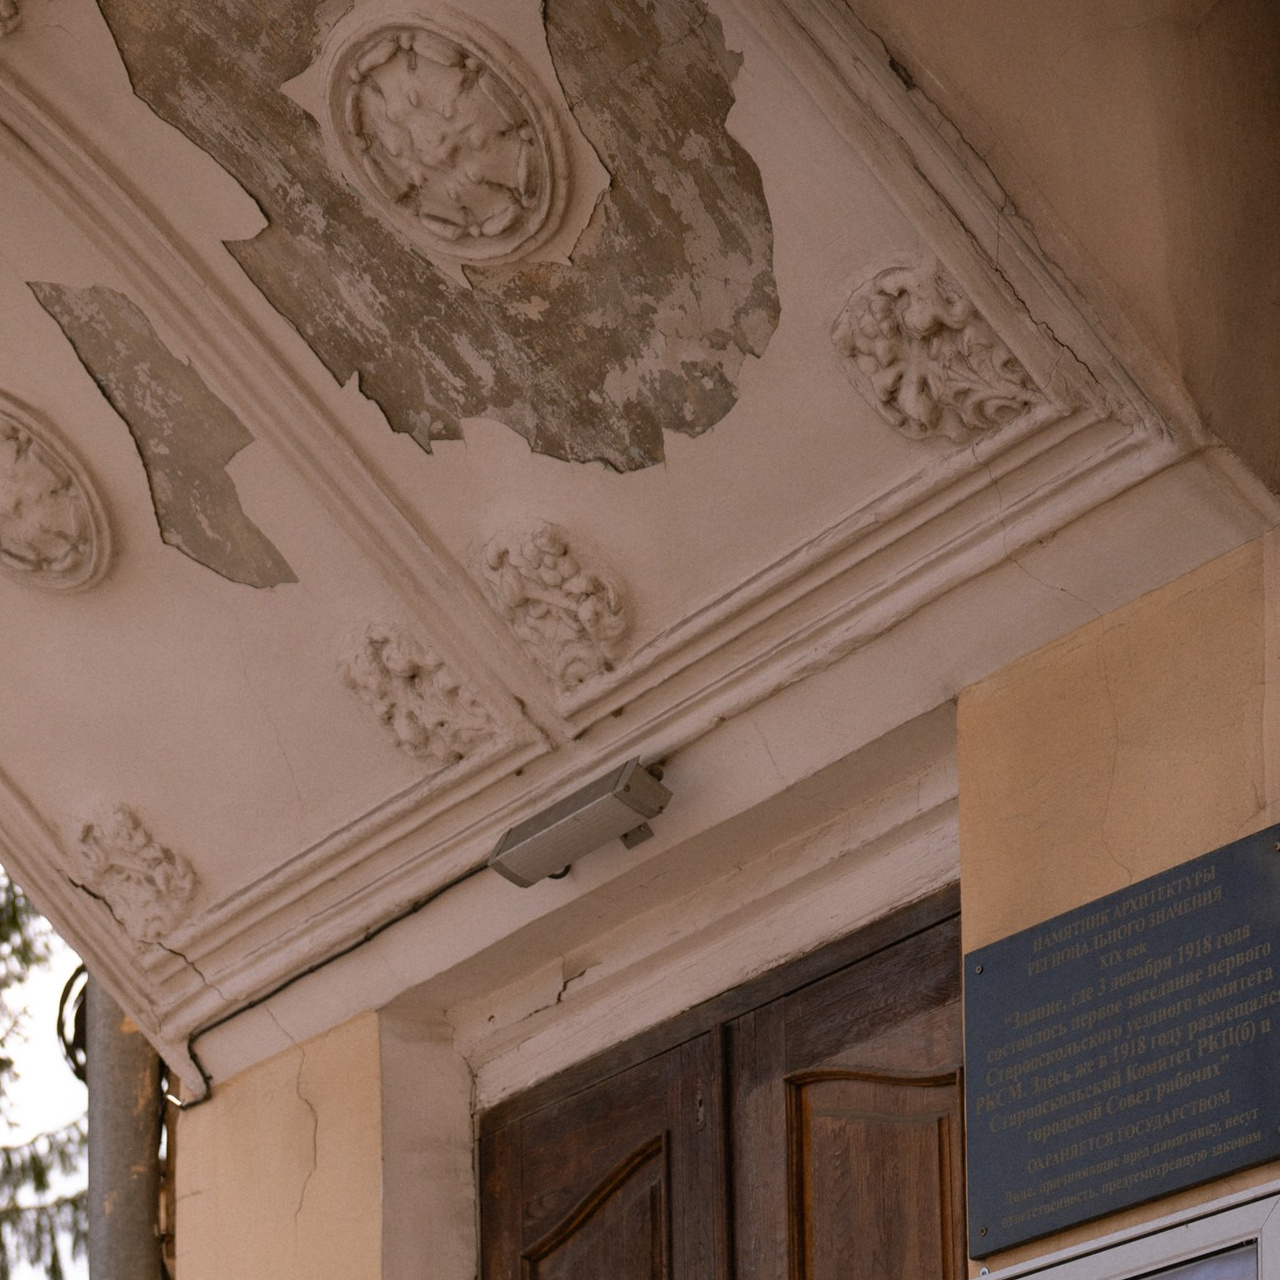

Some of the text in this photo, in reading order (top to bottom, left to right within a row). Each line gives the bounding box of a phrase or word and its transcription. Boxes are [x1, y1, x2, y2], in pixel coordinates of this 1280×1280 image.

[1027, 885, 1224, 978] РЕГИОНАЛЬНОГО ЗНАЧЕНИЯ
[1032, 865, 1216, 954] ПАМЯТНИК АРХИТЕКТУРЫ
[1126, 942, 1148, 961] век
[986, 942, 1272, 1064] состоялось первое заседание первого
[1070, 987, 1095, 1007] где
[1097, 977, 1107, 997] 3
[1110, 955, 1173, 993] декабря
[1178, 935, 1213, 965] 1918
[1219, 924, 1251, 949] года
[985, 966, 1273, 1087] Старооскольского уездного комитета
[1031, 1069, 1072, 1096] Здесь
[1073, 1060, 1095, 1080] же
[1098, 1055, 1108, 1070] в
[1112, 1035, 1147, 1064] 1918
[1150, 1026, 1184, 1050] году
[989, 1018, 1272, 1135] Старооскольский Комитет РКП(б) и
[1026, 1102, 1102, 1145] городской
[1105, 1086, 1152, 1116] Совет
[1026, 1089, 1232, 1174] ОХРАНЯЕТСЯ ГОСУДАРСТВОМ
[1101, 1148, 1208, 1196] предусмотренную
[1210, 1130, 1262, 1158] законом
[1123, 1146, 1150, 1167] вред
[1224, 1106, 1260, 1128] несут
